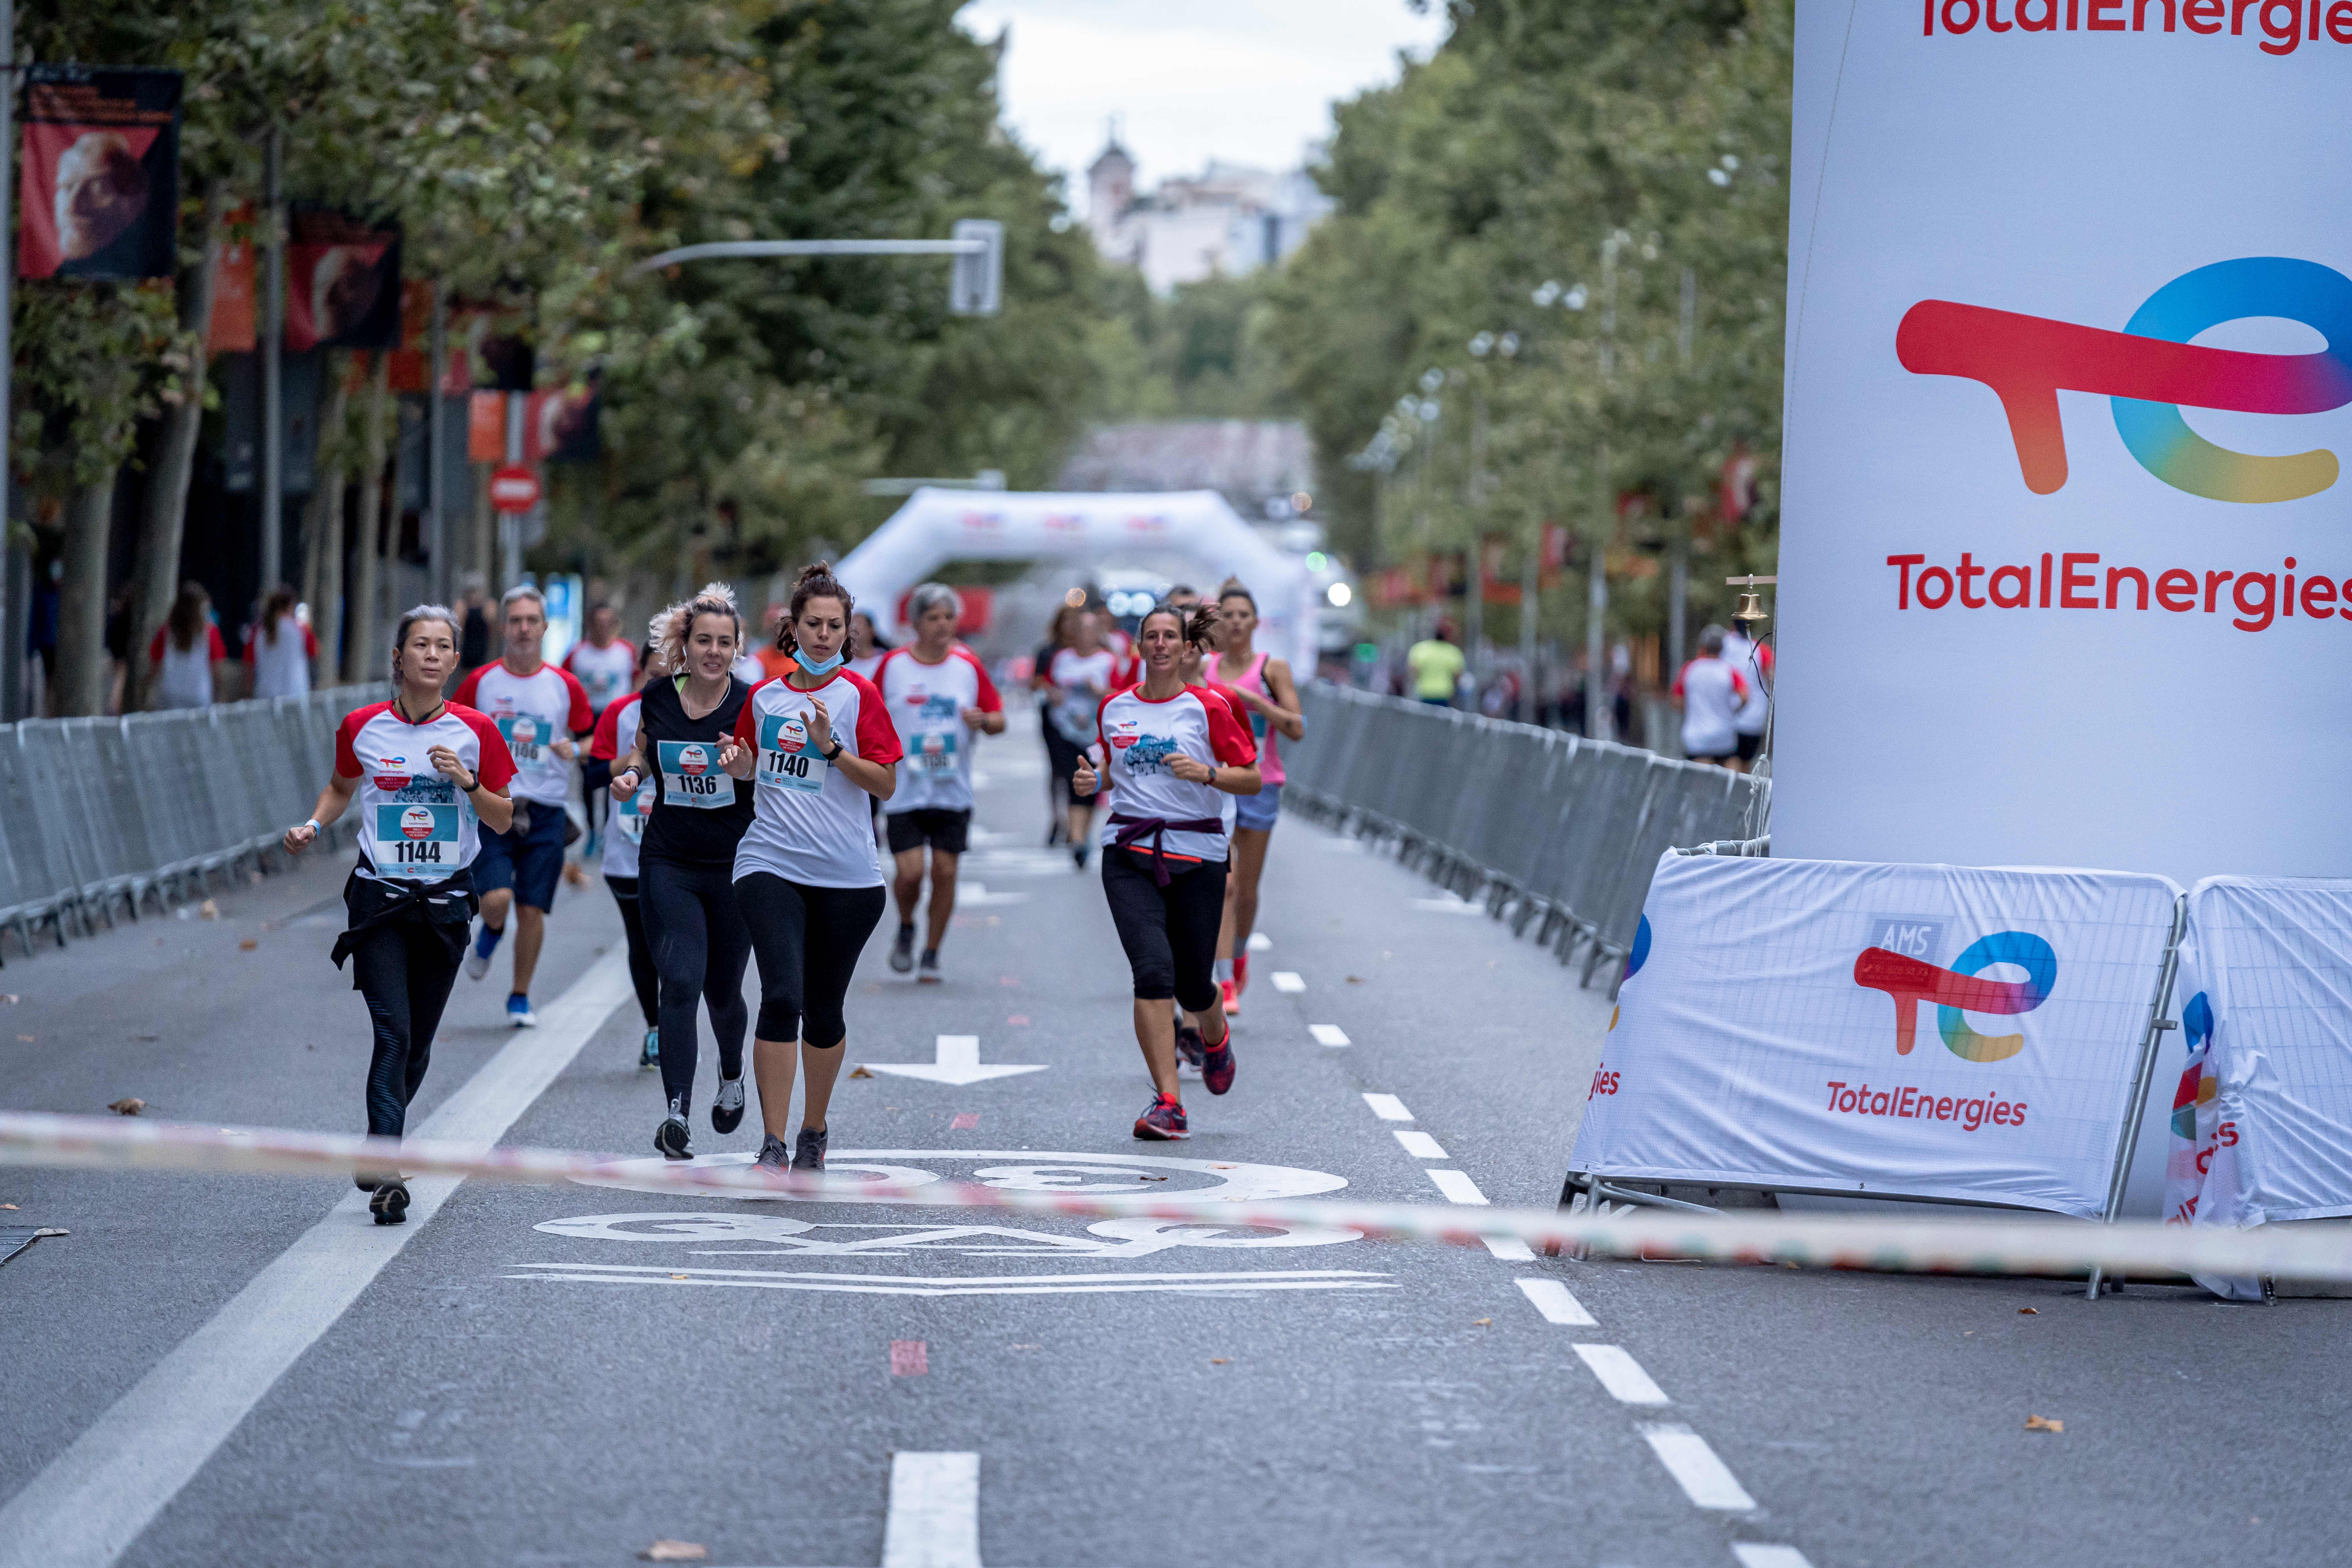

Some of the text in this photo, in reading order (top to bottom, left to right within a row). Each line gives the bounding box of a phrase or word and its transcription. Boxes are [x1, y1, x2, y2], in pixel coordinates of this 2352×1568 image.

[769, 751, 809, 778] 1140
[678, 775, 717, 795] 1136
[395, 841, 441, 863] 1144
[1879, 923, 1932, 956] AMS
[1827, 1081, 2028, 1132] TotalEnergies
